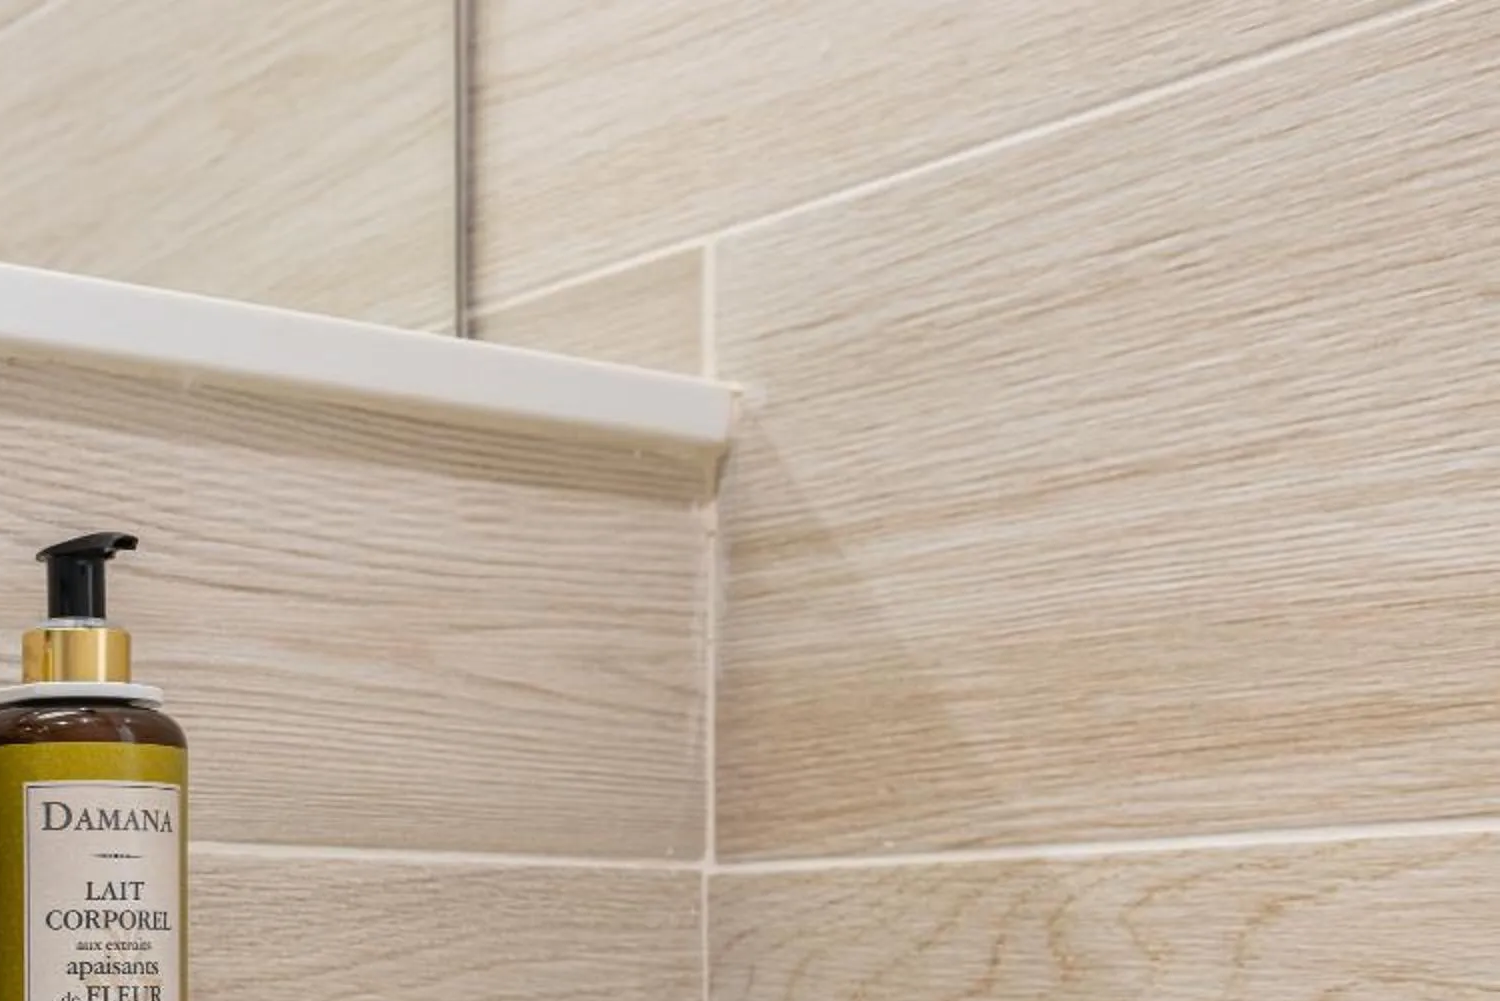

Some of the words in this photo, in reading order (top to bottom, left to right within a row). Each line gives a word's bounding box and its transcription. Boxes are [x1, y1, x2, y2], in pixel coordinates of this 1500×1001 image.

[41, 801, 174, 833] DAMANA
[86, 881, 145, 901] LAIT
[45, 909, 172, 931] CORPOREL
[75, 941, 102, 951] aux
[67, 955, 160, 981] apaisants
